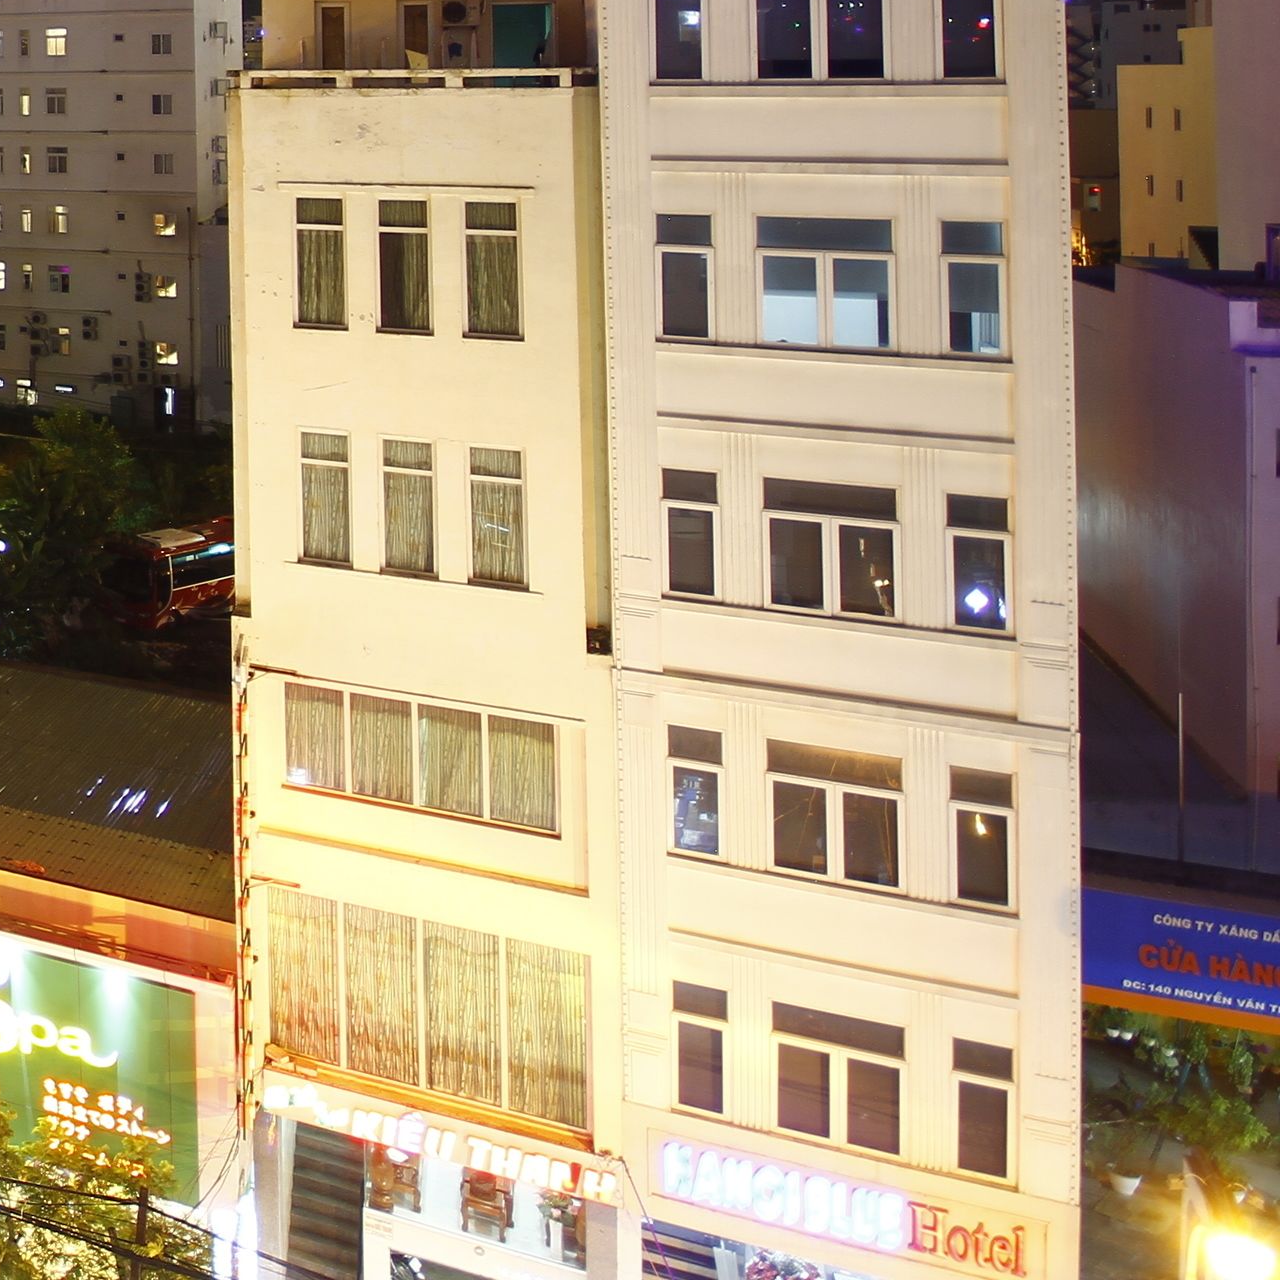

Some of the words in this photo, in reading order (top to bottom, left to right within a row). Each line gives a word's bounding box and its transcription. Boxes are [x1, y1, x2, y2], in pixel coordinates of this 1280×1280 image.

[1153, 913, 1192, 929] CÔNG
[1195, 920, 1214, 933] TY
[1138, 938, 1202, 977] CỬA
[1148, 984, 1172, 995] 140
[465, 1134, 618, 1203] THANH
[662, 1140, 802, 1226] HANOI
[803, 1175, 906, 1251] BLUE
[907, 1200, 1029, 1279] Hotel
